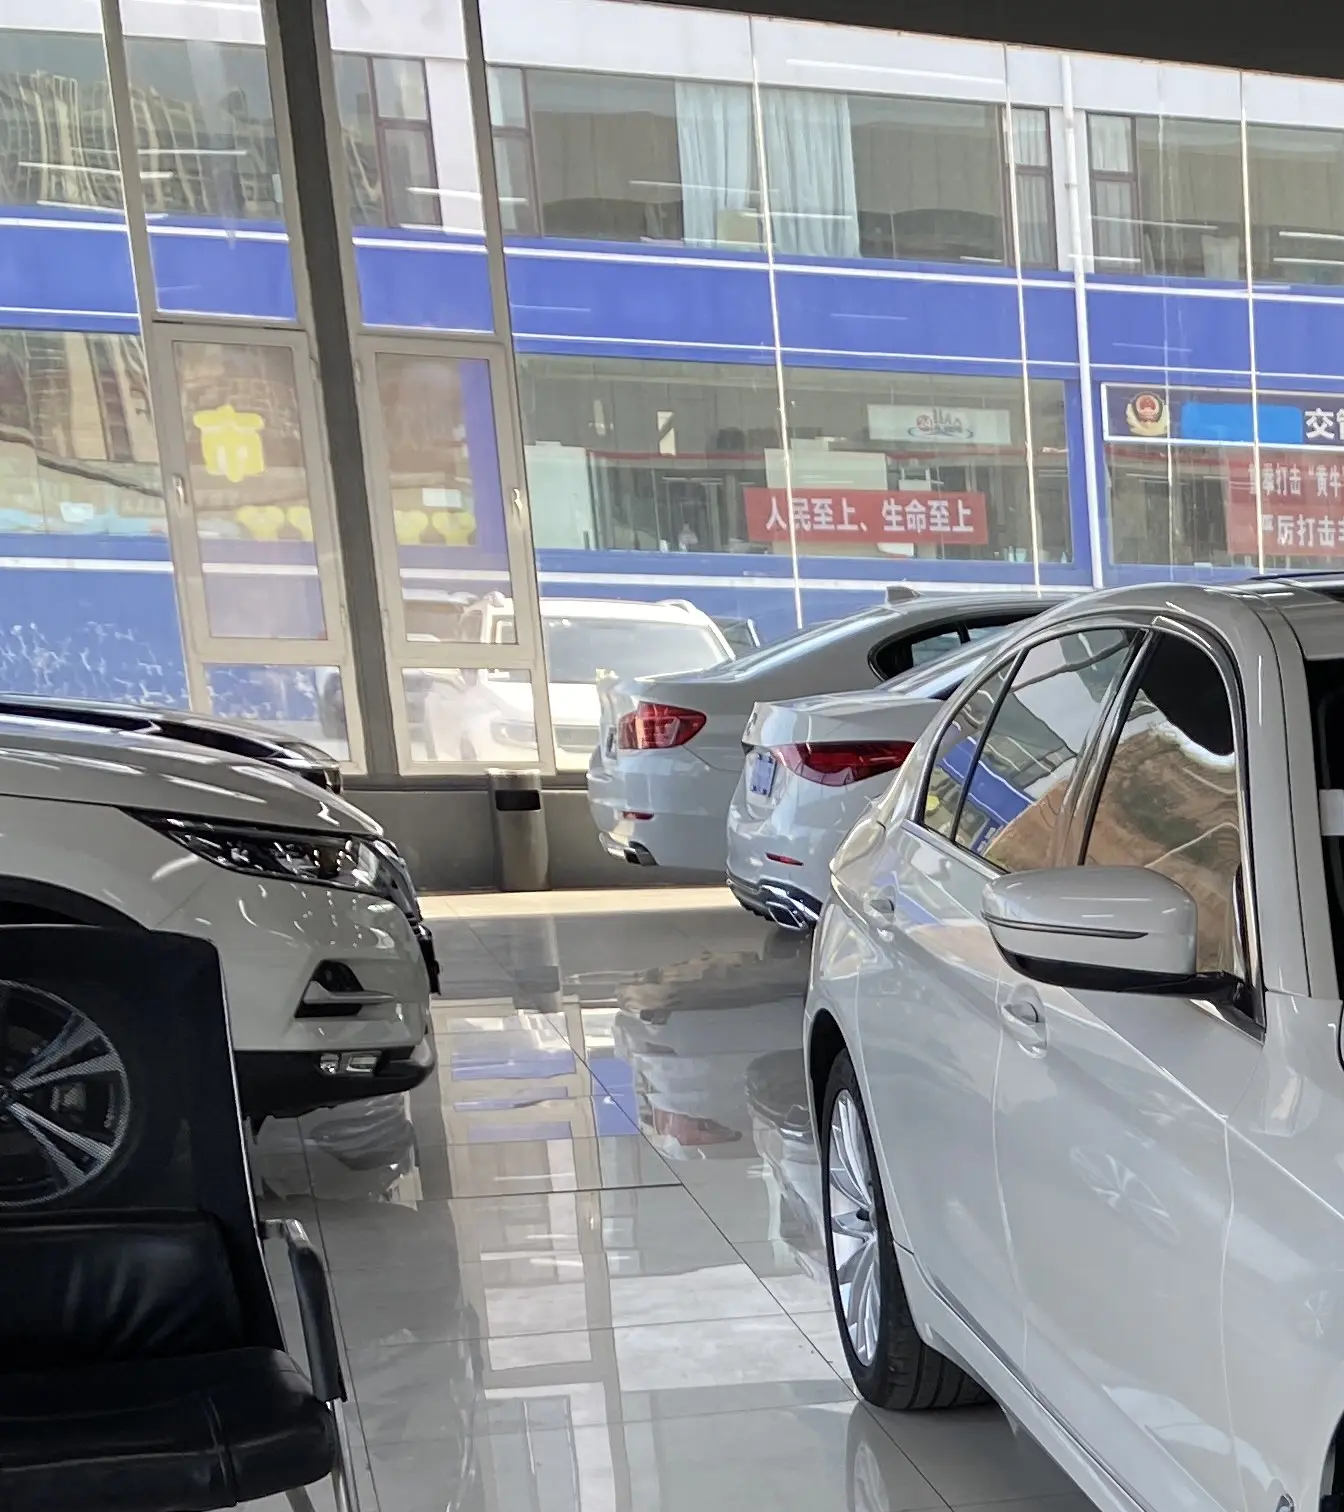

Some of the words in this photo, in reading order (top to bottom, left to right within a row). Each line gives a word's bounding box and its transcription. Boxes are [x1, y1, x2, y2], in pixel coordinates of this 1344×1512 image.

[765, 496, 974, 533] 人民至上、生命至上
